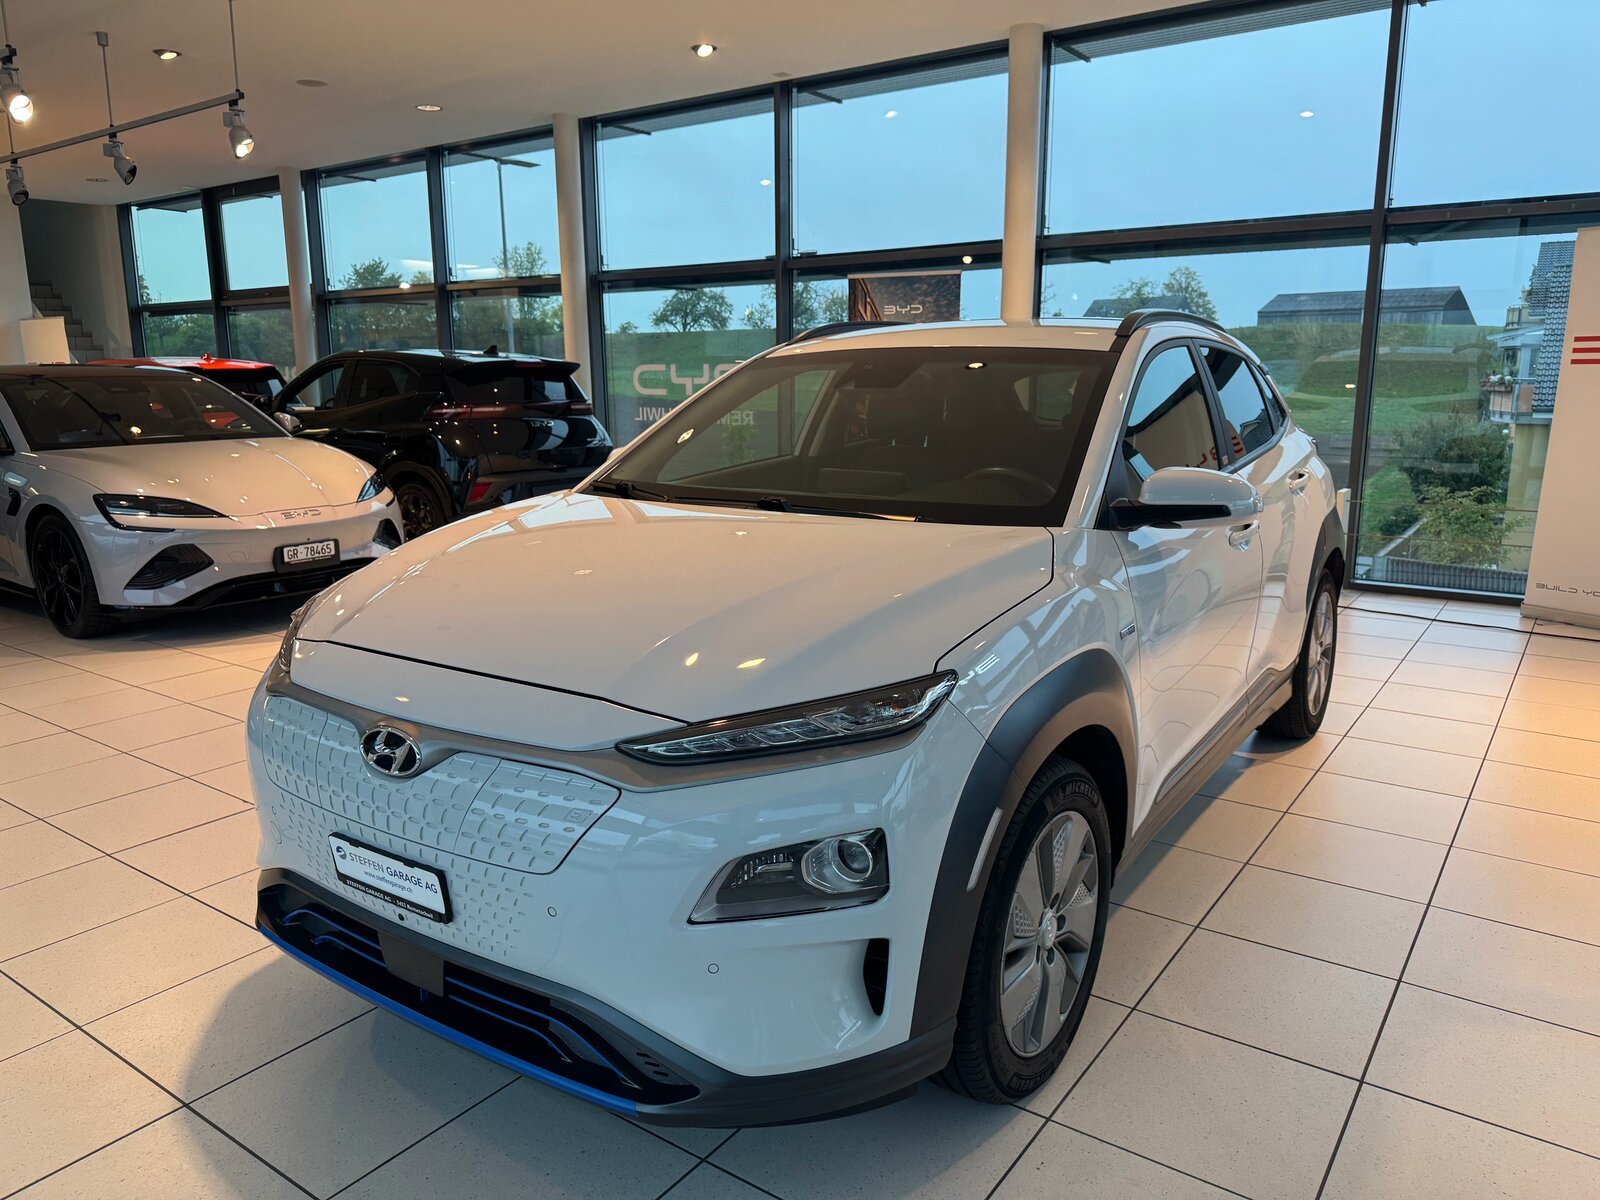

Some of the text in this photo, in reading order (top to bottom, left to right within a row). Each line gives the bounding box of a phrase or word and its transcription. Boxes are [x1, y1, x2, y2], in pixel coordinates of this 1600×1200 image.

[883, 304, 923, 315] BYD
[1535, 582, 1578, 594] BUILD
[348, 852, 438, 894] STEFFEN GARAGE AG
[363, 869, 414, 894] www.steffengarage.ch
[346, 879, 366, 892] STEFFEN
[365, 886, 385, 900] GARAGE
